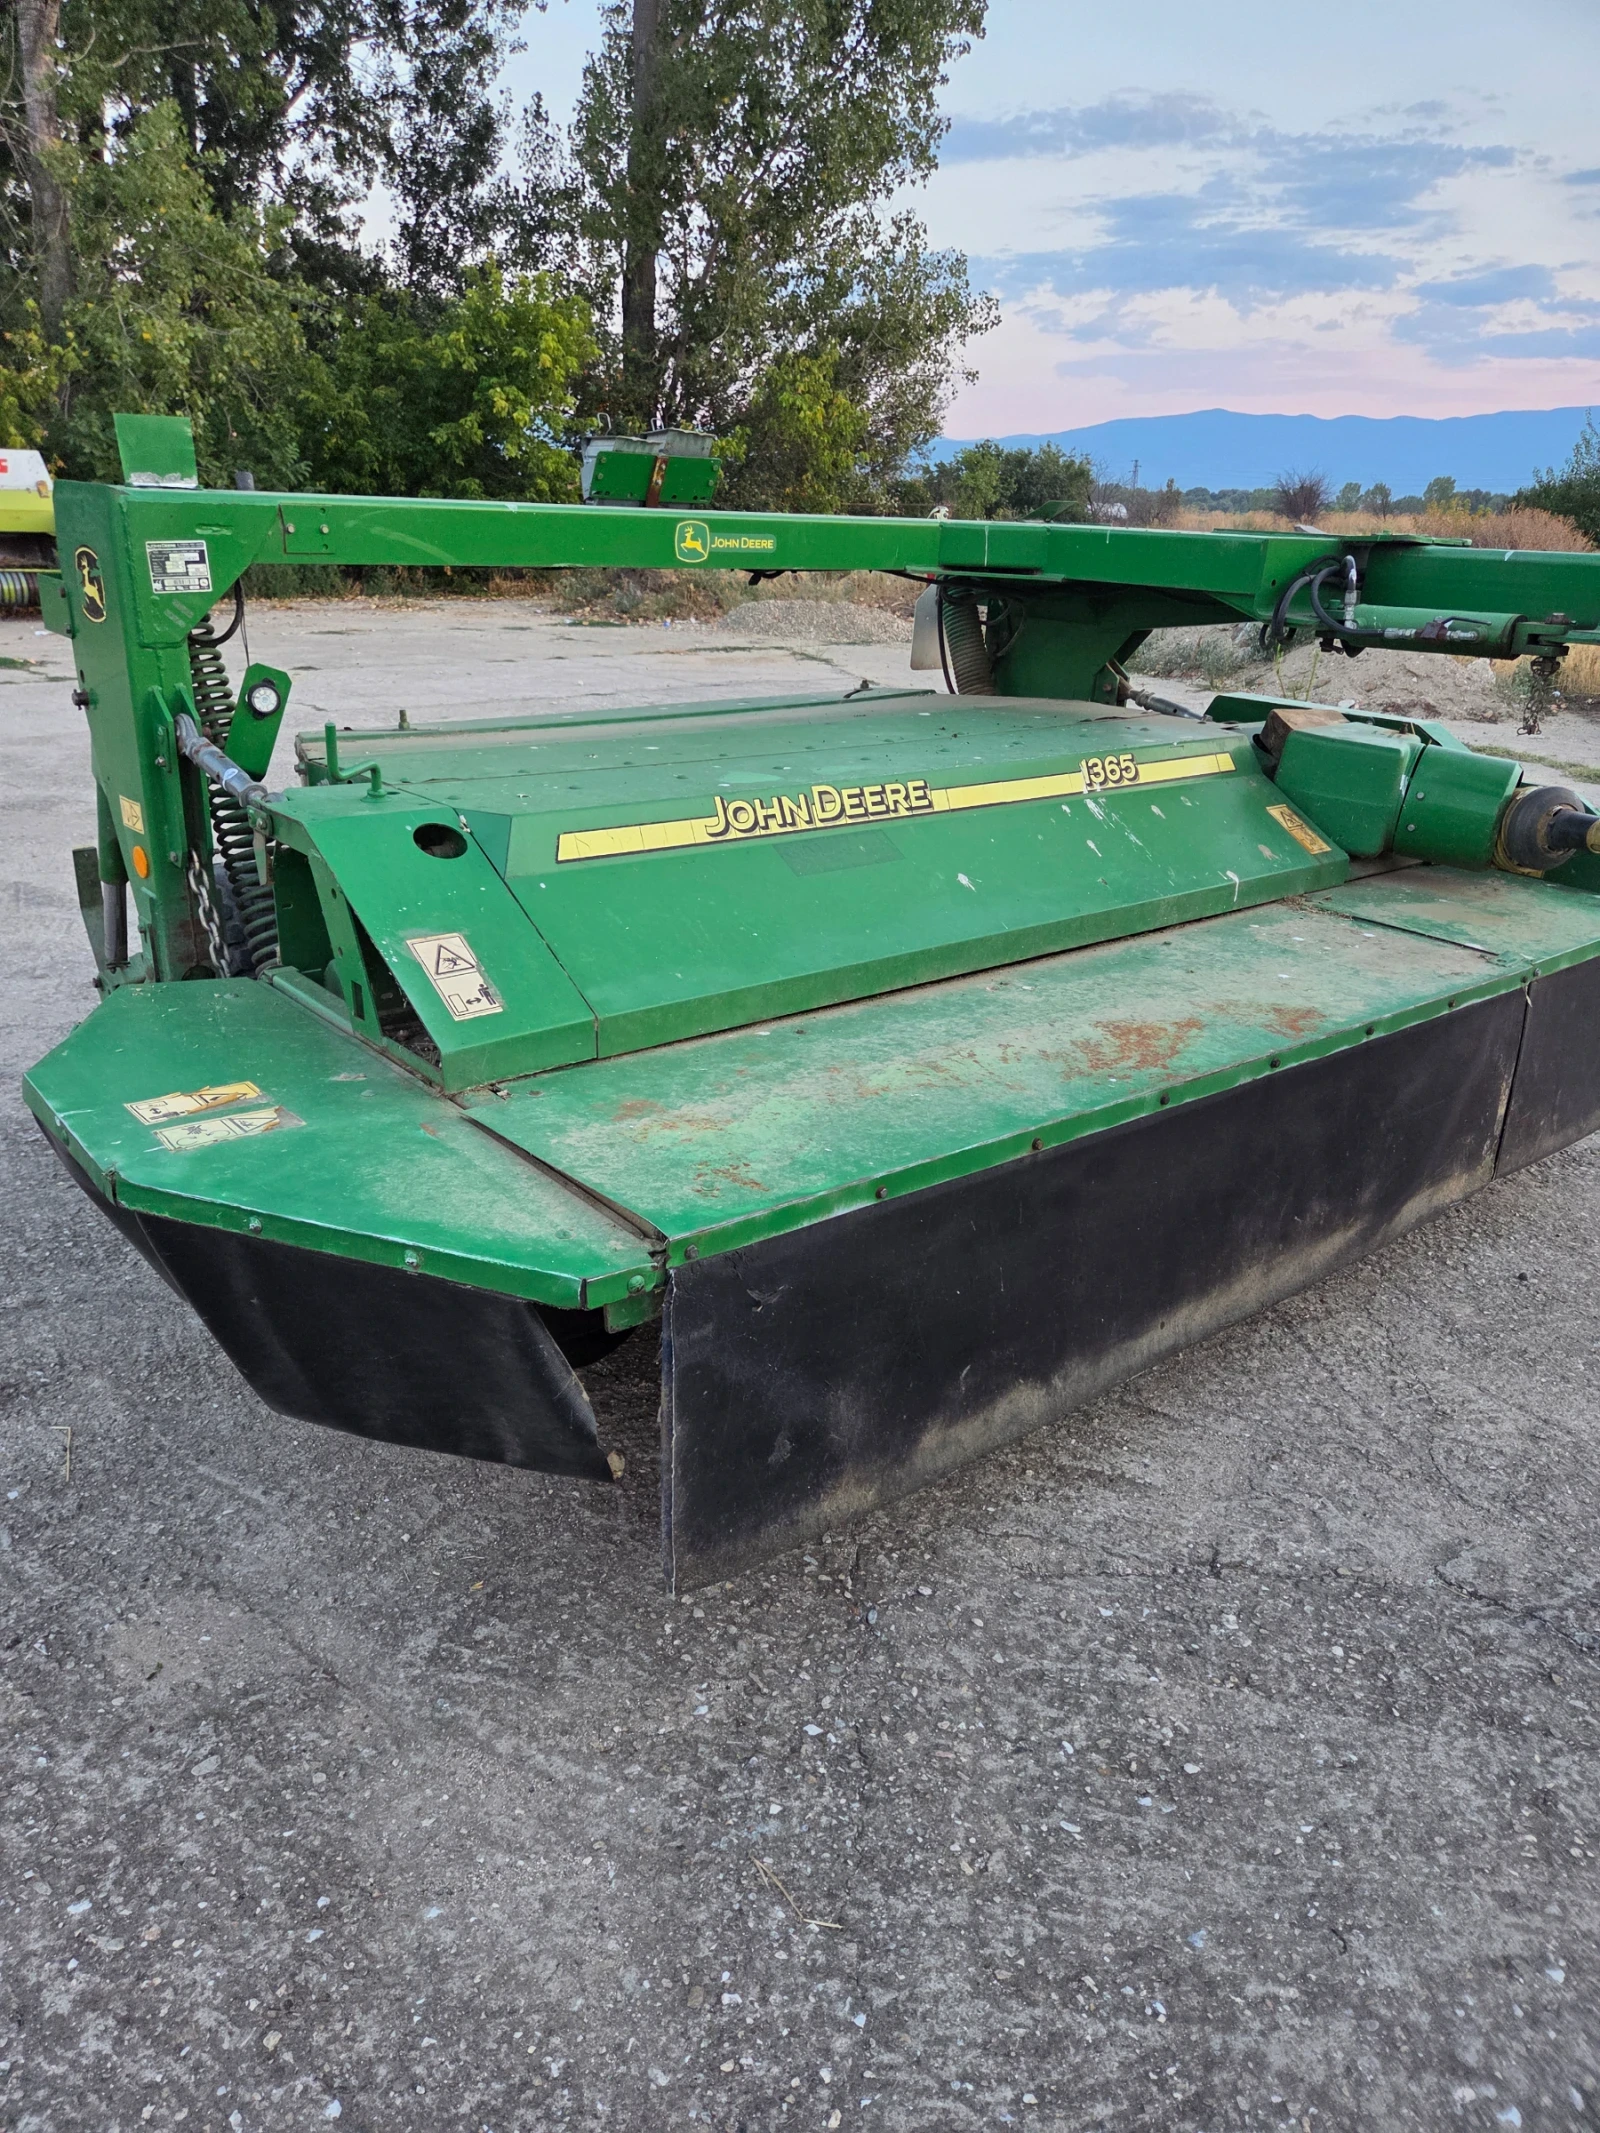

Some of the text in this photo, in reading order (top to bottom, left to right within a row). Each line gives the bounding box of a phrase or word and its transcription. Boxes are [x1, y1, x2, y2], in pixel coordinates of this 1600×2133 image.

[711, 536, 774, 549] JOHN DEERE
[1079, 752, 1139, 787] 1365
[704, 779, 931, 837] JOHN DEERE
